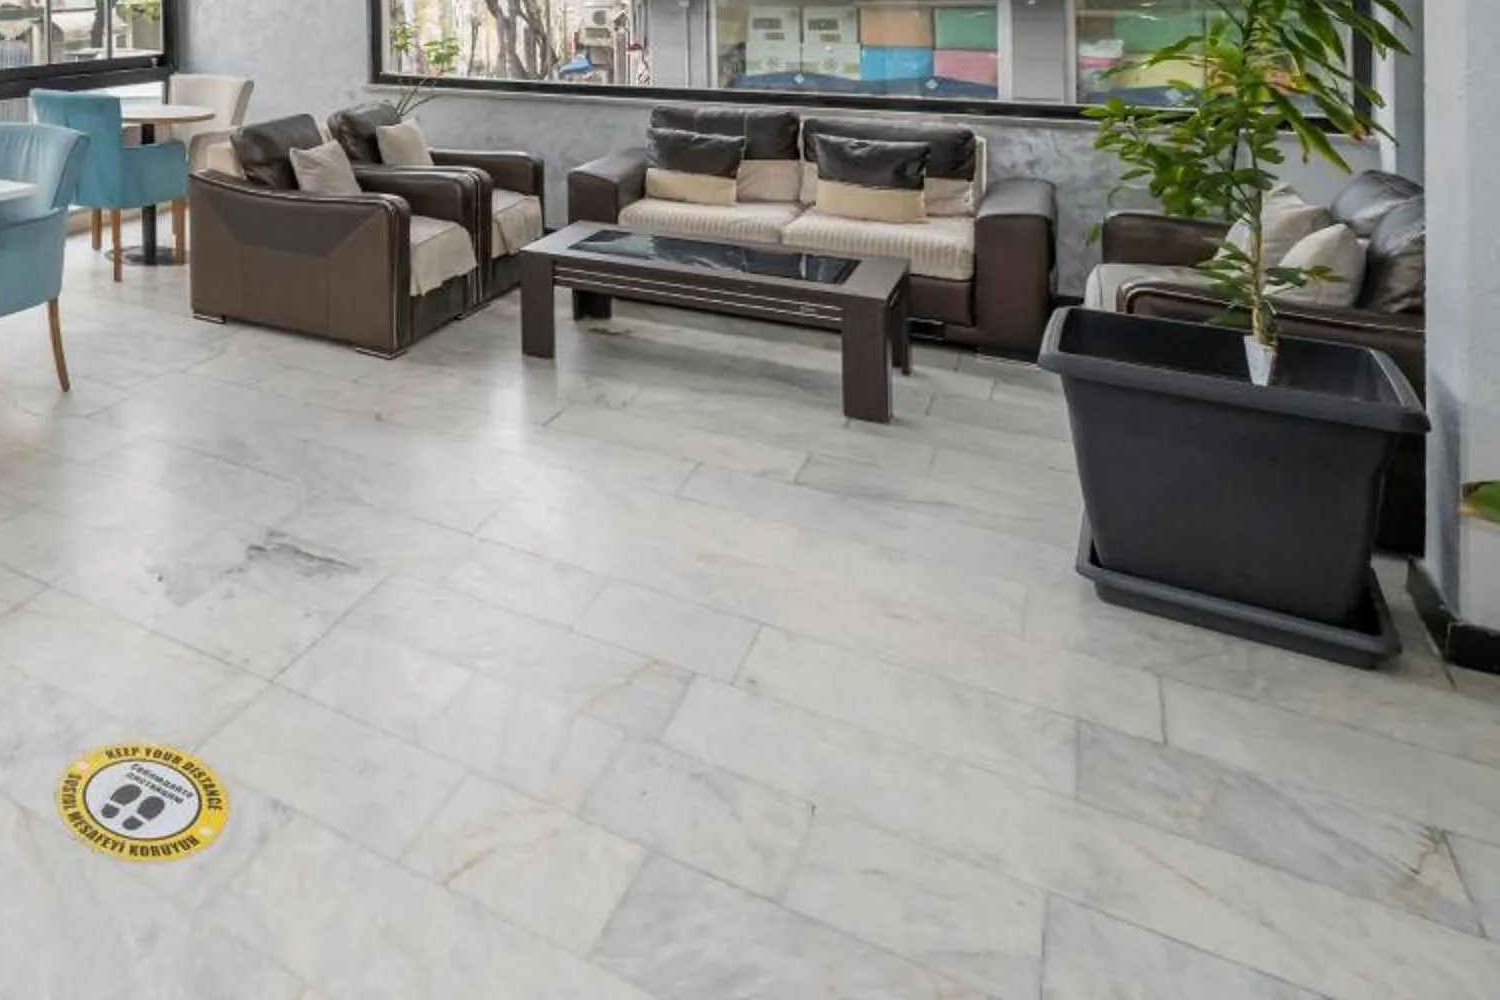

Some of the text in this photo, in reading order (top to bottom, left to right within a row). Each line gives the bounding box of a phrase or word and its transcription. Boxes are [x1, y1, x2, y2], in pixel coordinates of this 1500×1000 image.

[105, 747, 139, 759] KEEP
[144, 747, 183, 764] YOUR
[129, 834, 200, 857] KORUYUN
